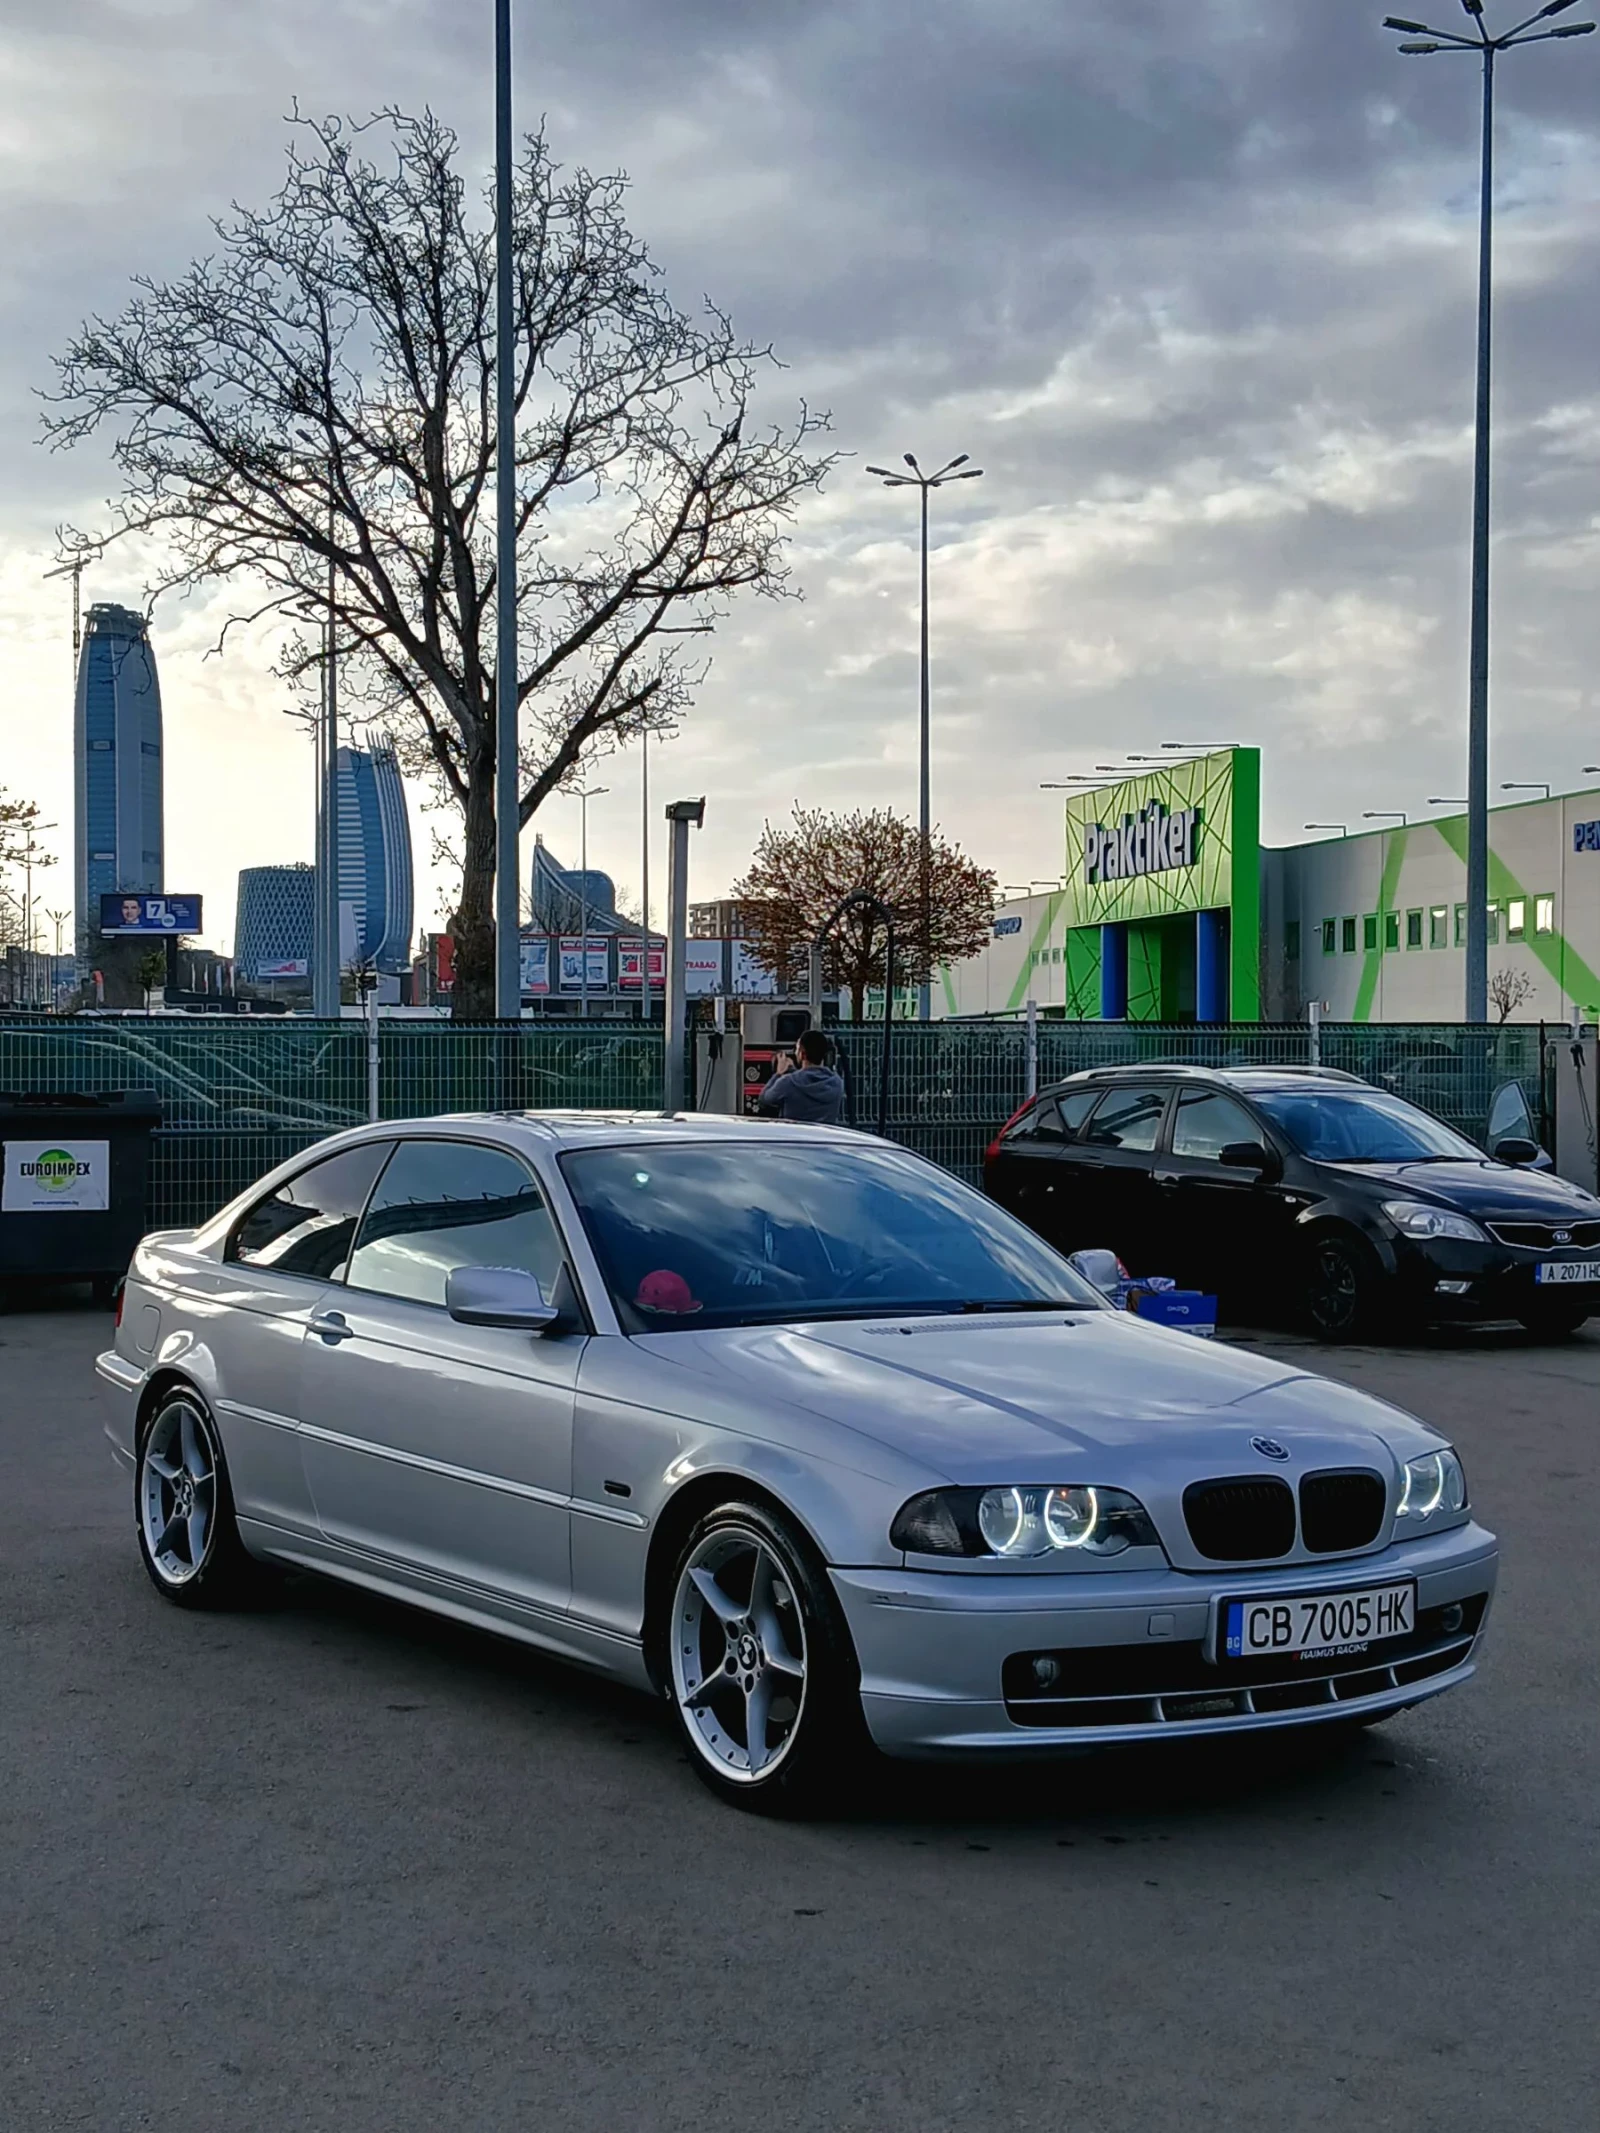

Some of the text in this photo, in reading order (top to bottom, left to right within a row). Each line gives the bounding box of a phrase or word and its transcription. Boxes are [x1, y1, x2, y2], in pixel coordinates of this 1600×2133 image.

[1084, 799, 1200, 884] Praktiker
[150, 903, 161, 917] 7
[20, 1161, 91, 1178] EUROIMPEX
[1547, 1265, 1555, 1280] A
[1249, 1590, 1410, 1648] CB 7005 HK
